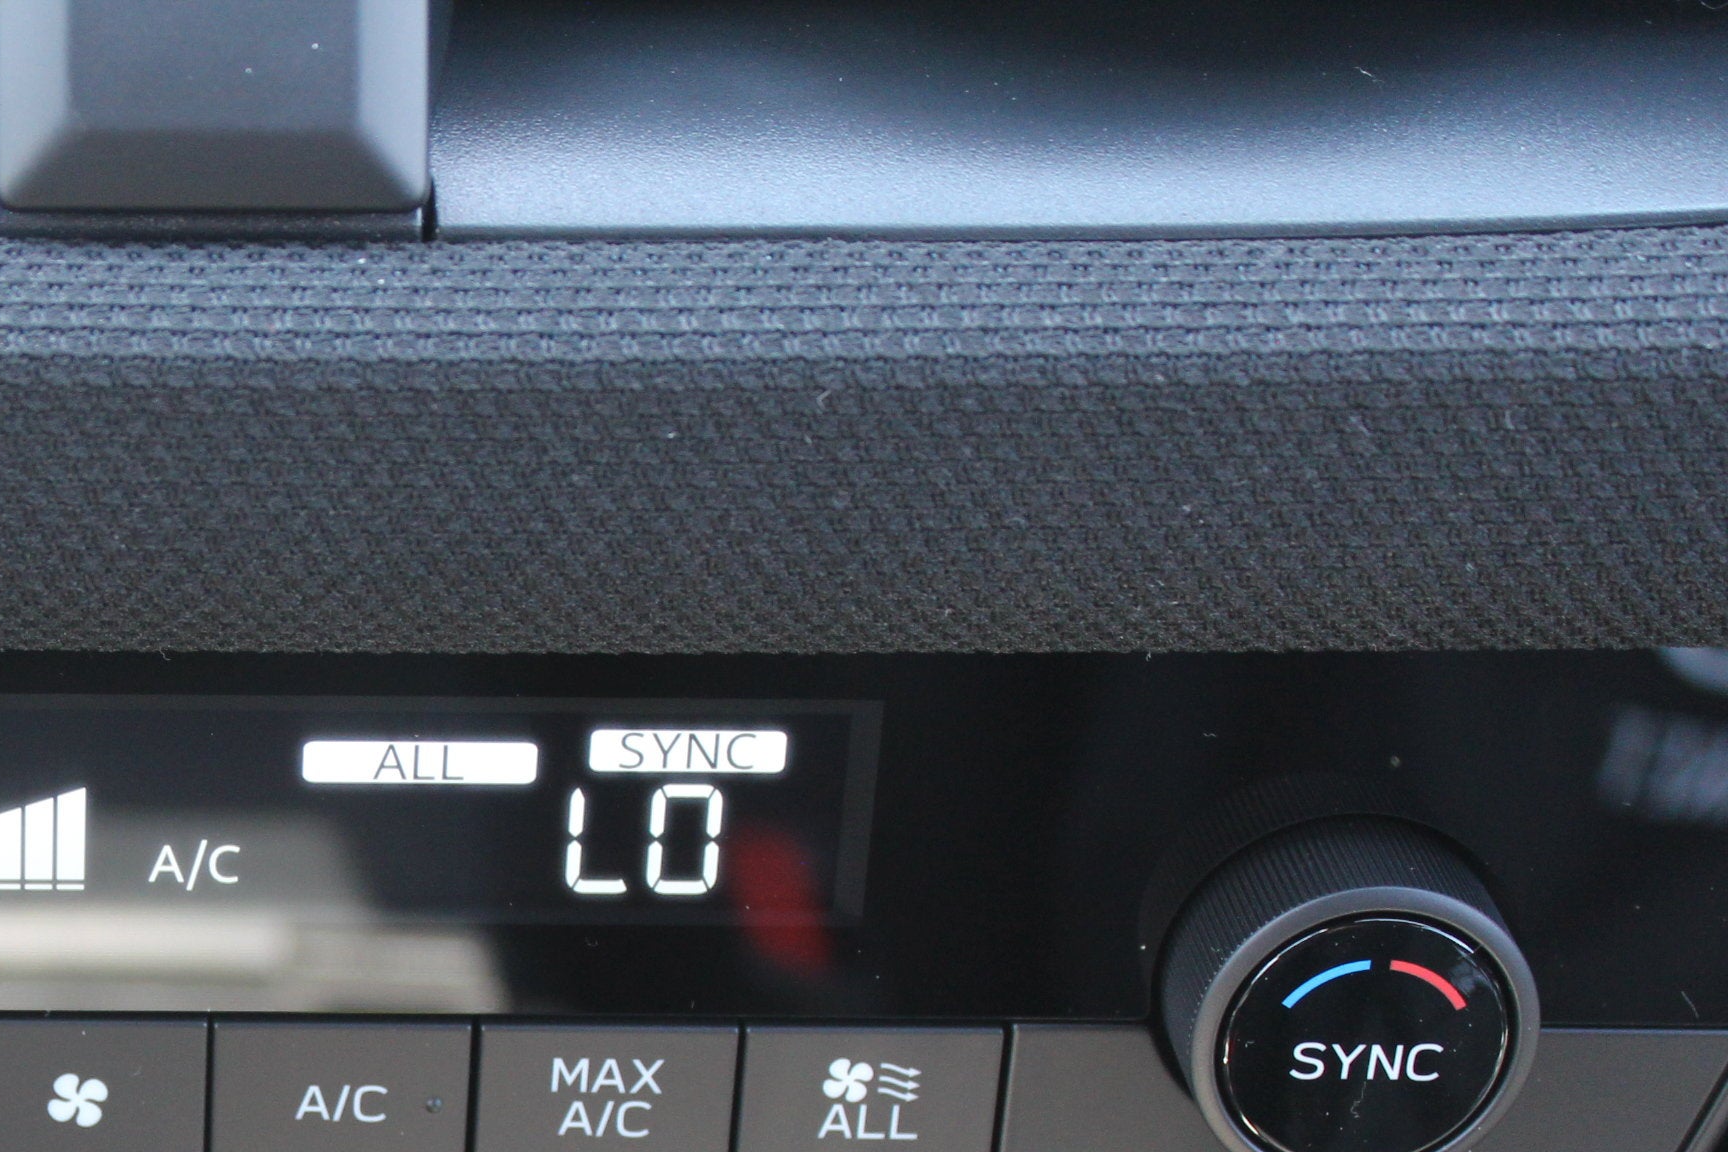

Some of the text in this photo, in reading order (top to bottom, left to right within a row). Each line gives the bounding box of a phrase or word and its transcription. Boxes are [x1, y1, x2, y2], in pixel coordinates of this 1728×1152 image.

[373, 743, 464, 781] ALL
[618, 732, 758, 773] SYNC
[148, 840, 241, 891] A/C
[551, 1058, 665, 1094] MAX
[1289, 1042, 1444, 1082] SYNC
[296, 1085, 388, 1123] A/C
[559, 1101, 651, 1138] A/C
[818, 1102, 918, 1140] ALL
